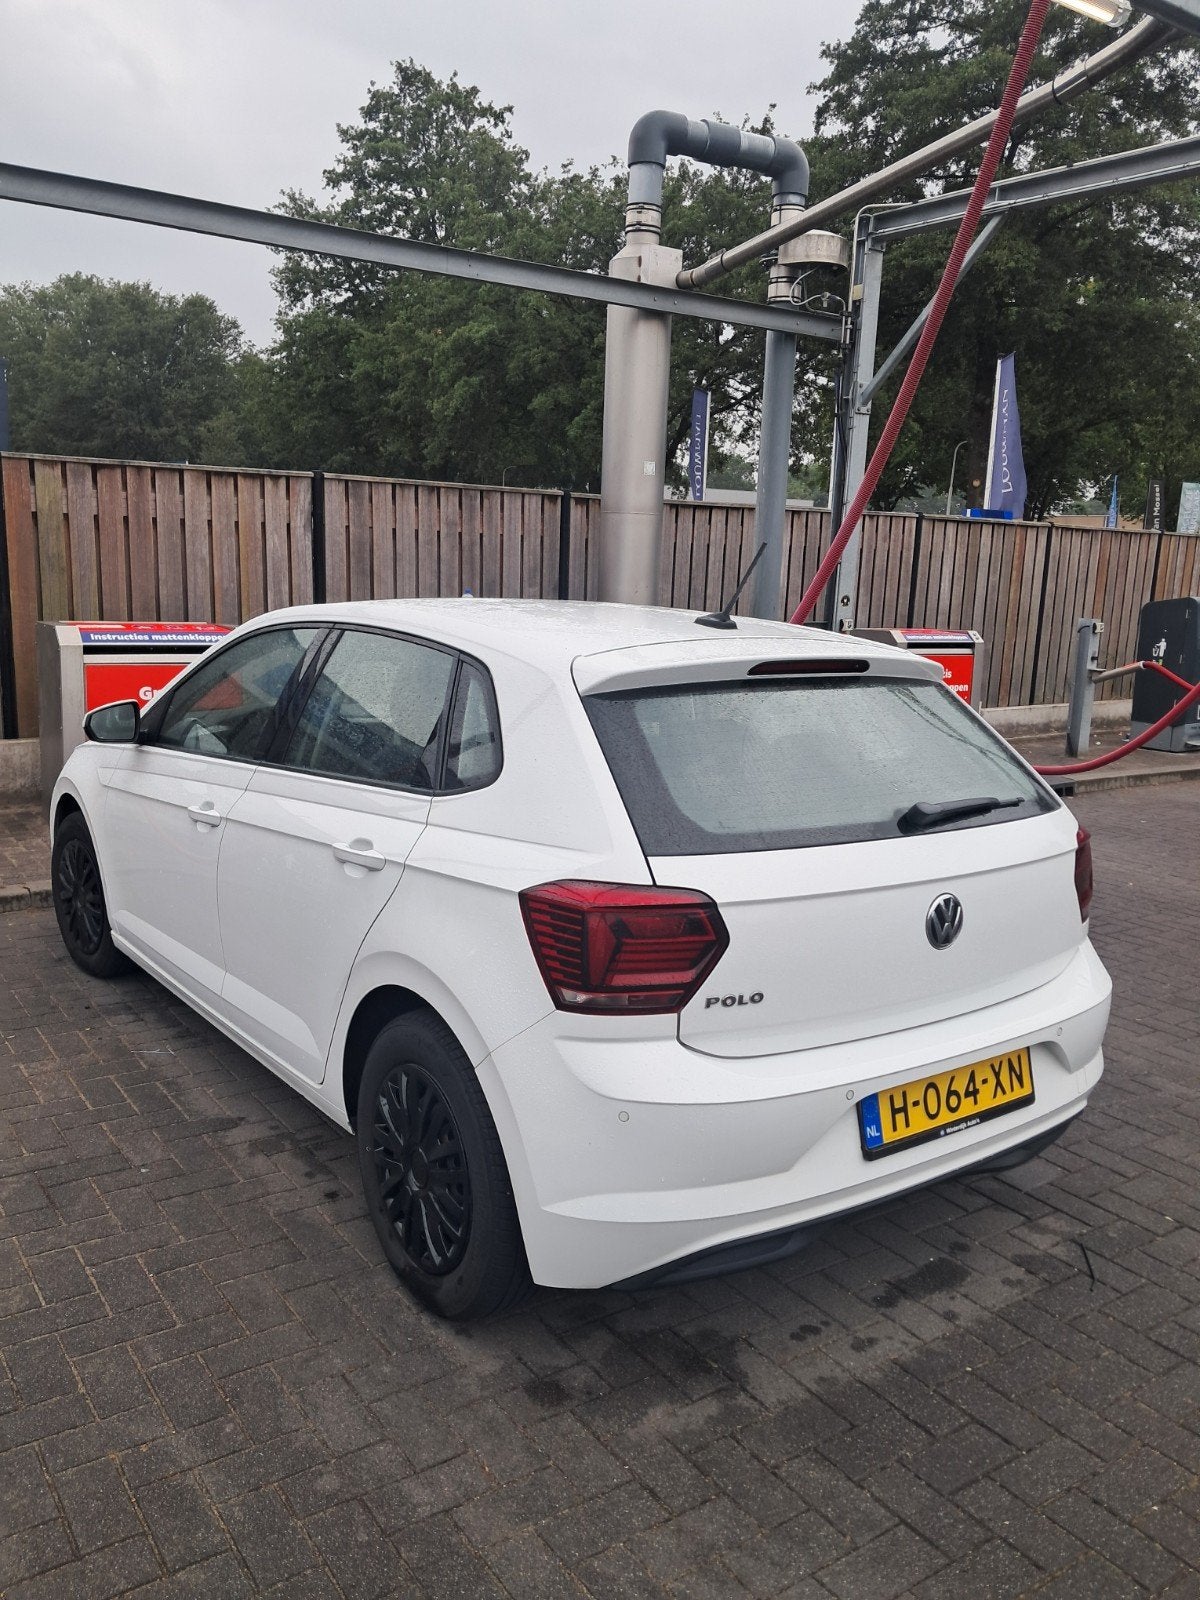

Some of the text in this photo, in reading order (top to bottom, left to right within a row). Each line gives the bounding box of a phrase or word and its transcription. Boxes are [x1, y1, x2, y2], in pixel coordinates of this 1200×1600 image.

[90, 633, 225, 642] Instructies mattenkloppe
[704, 991, 764, 1009] POLO
[889, 1054, 1025, 1132] H-064-XN
[866, 1124, 880, 1138] NL
